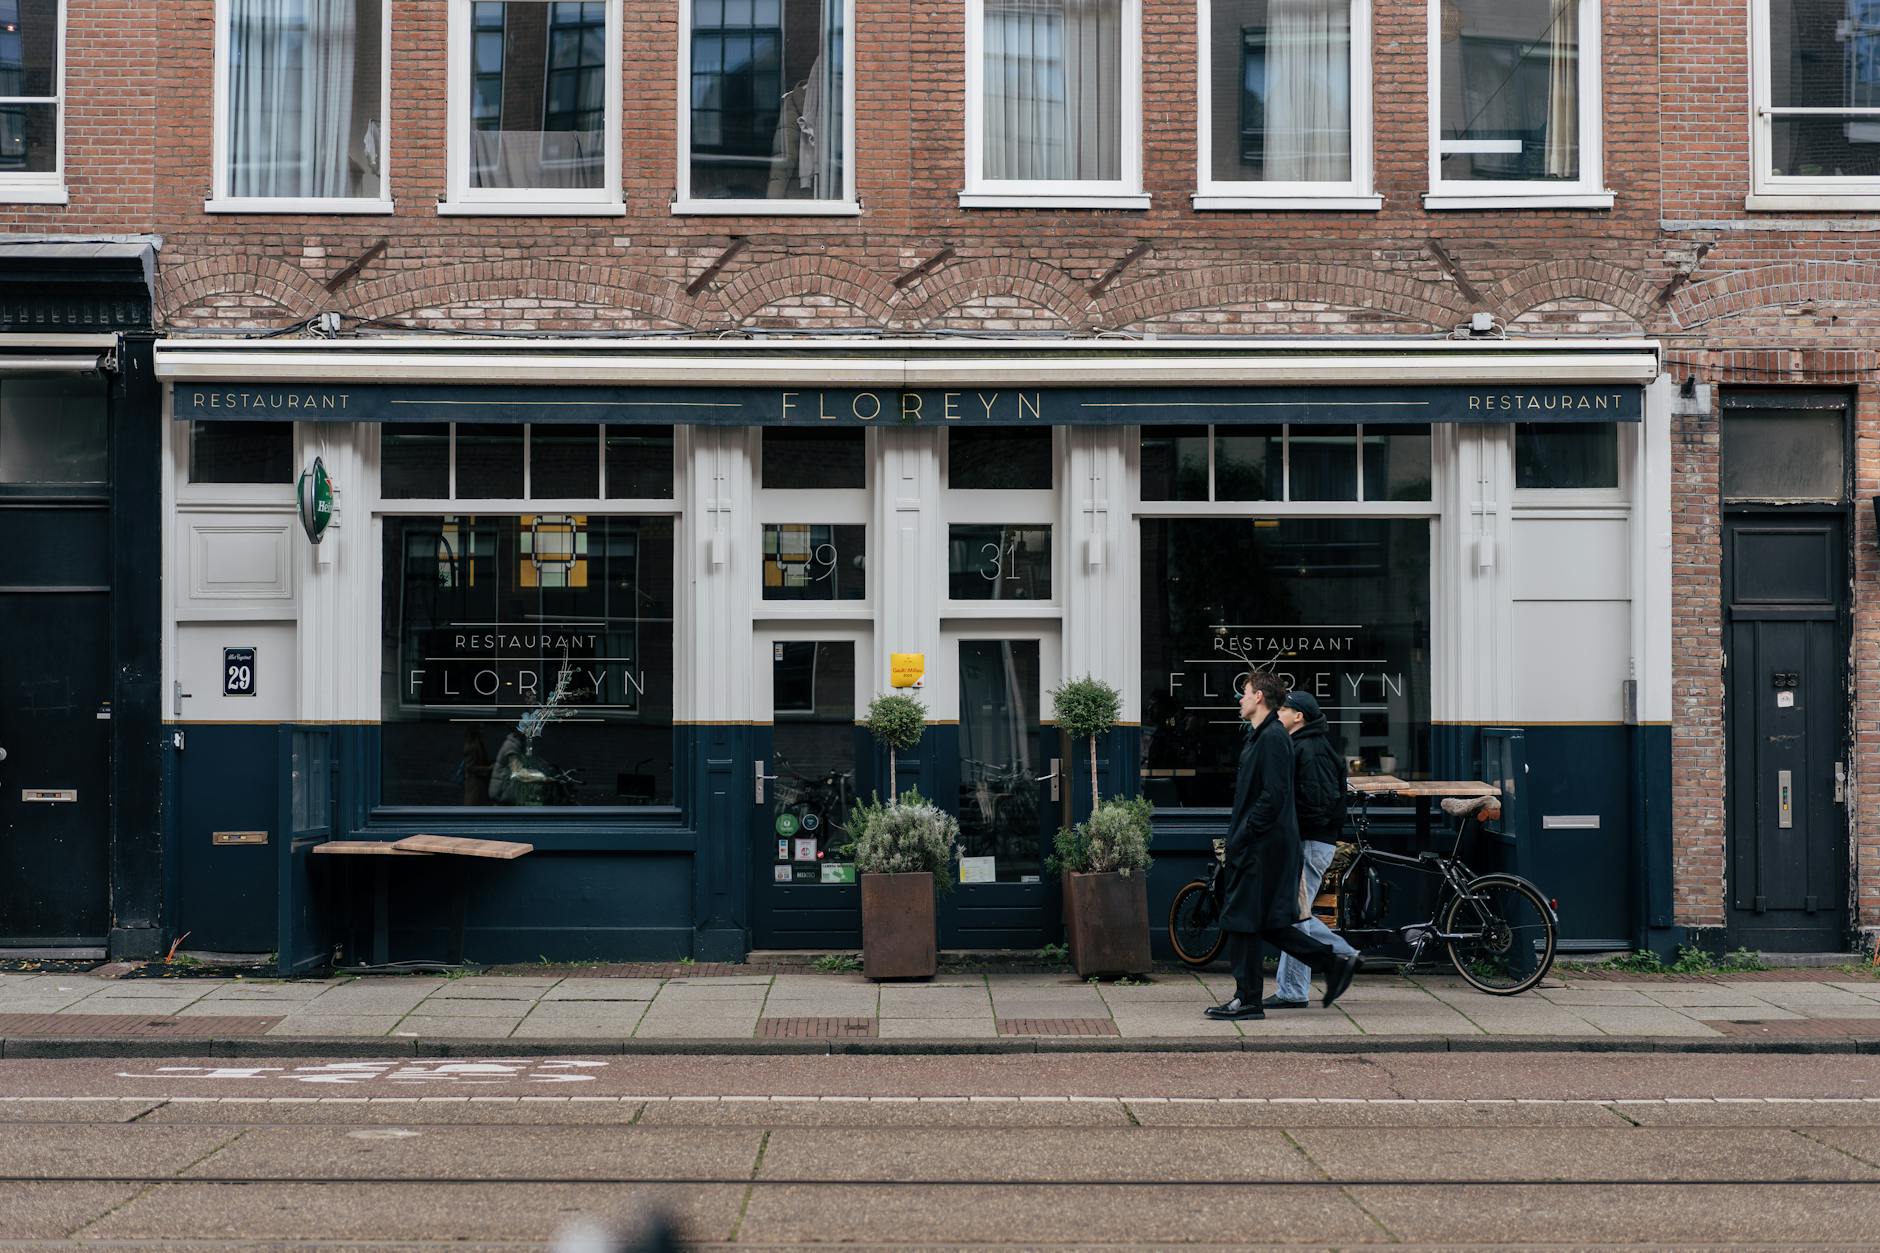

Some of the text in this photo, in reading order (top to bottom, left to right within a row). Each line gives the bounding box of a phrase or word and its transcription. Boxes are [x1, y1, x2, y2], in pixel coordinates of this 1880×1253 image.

[193, 393, 350, 409] RESTAURANT
[782, 392, 1040, 420] FLOREYN
[1469, 394, 1623, 410] RESTAURANT
[980, 543, 1021, 581] 31
[455, 635, 597, 648] RESTAURANT
[1213, 637, 1354, 651] RESTAURANT
[227, 665, 250, 690] 29
[410, 670, 645, 696] FLOREYN
